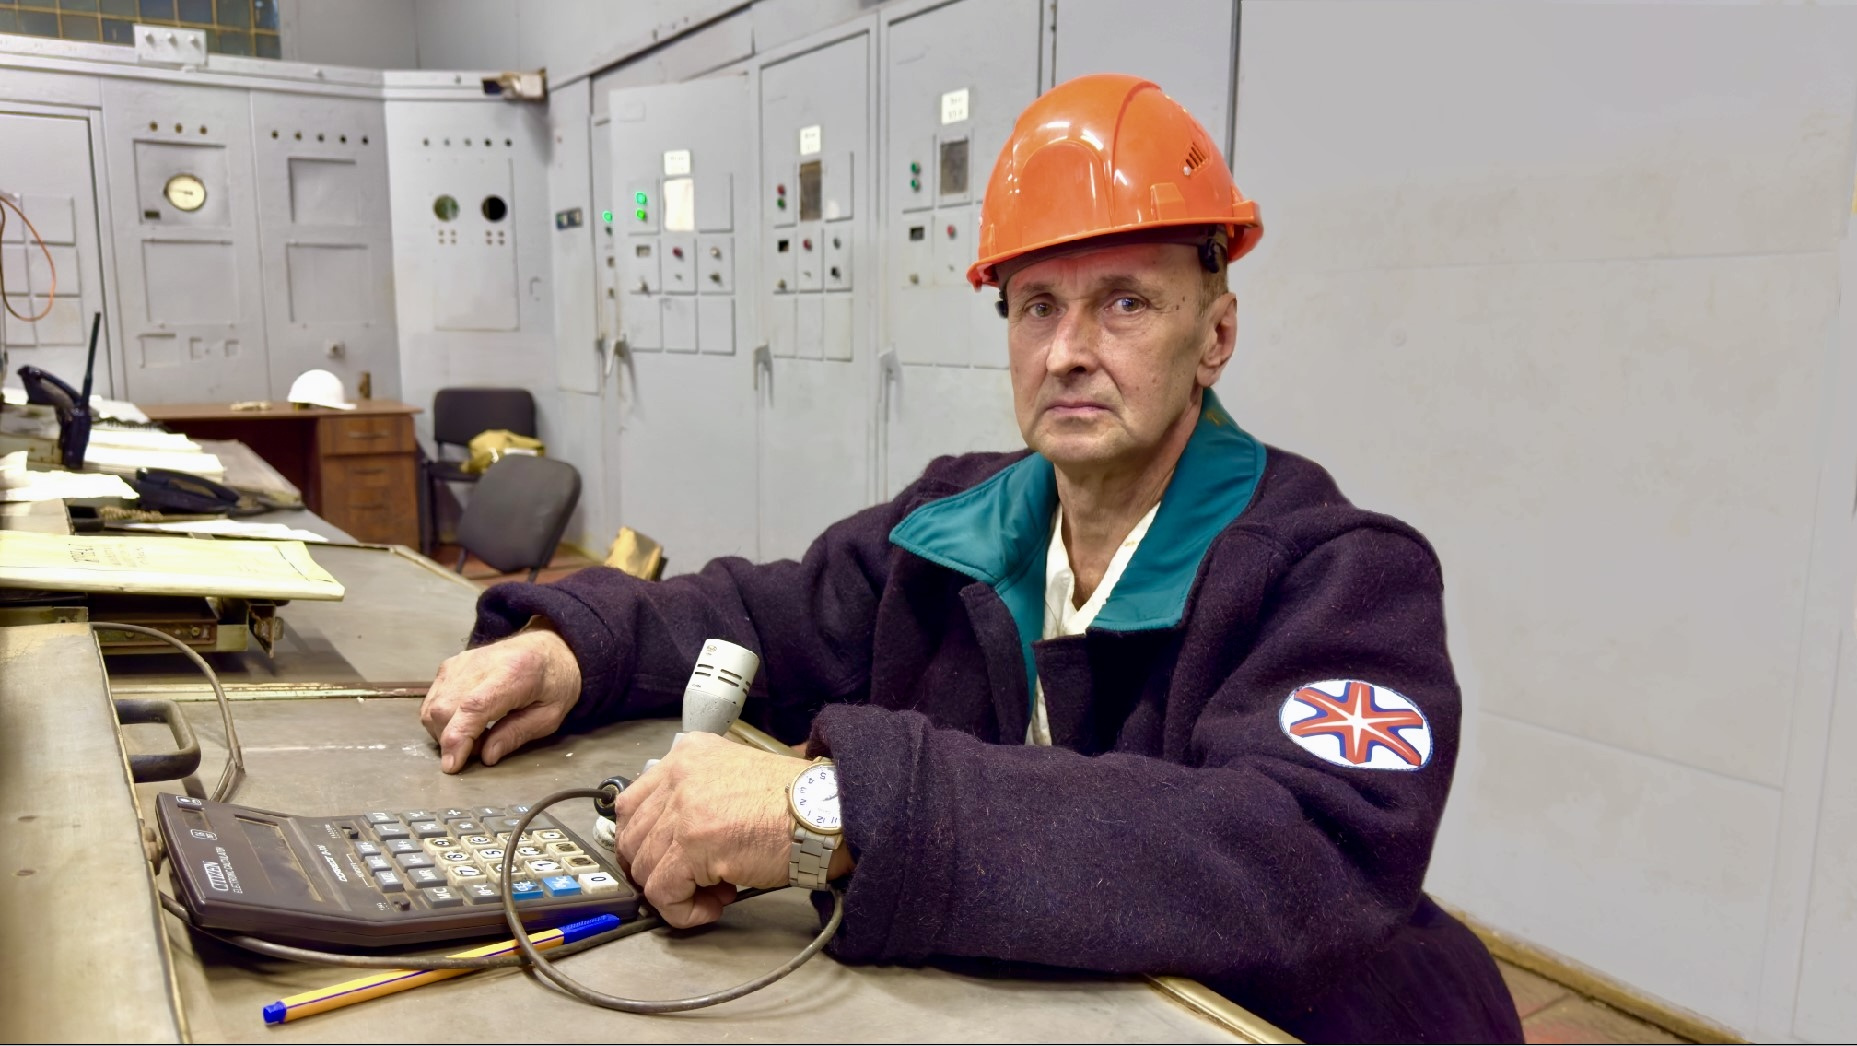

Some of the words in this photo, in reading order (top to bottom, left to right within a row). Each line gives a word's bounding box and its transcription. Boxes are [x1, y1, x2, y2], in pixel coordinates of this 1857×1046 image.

[820, 772, 827, 780] 5
[800, 798, 807, 806] 2
[816, 816, 826, 824] 12
[831, 816, 838, 824] 11
[204, 861, 229, 891] CITIZEN
[418, 869, 438, 880] MR
[432, 887, 451, 899] MC
